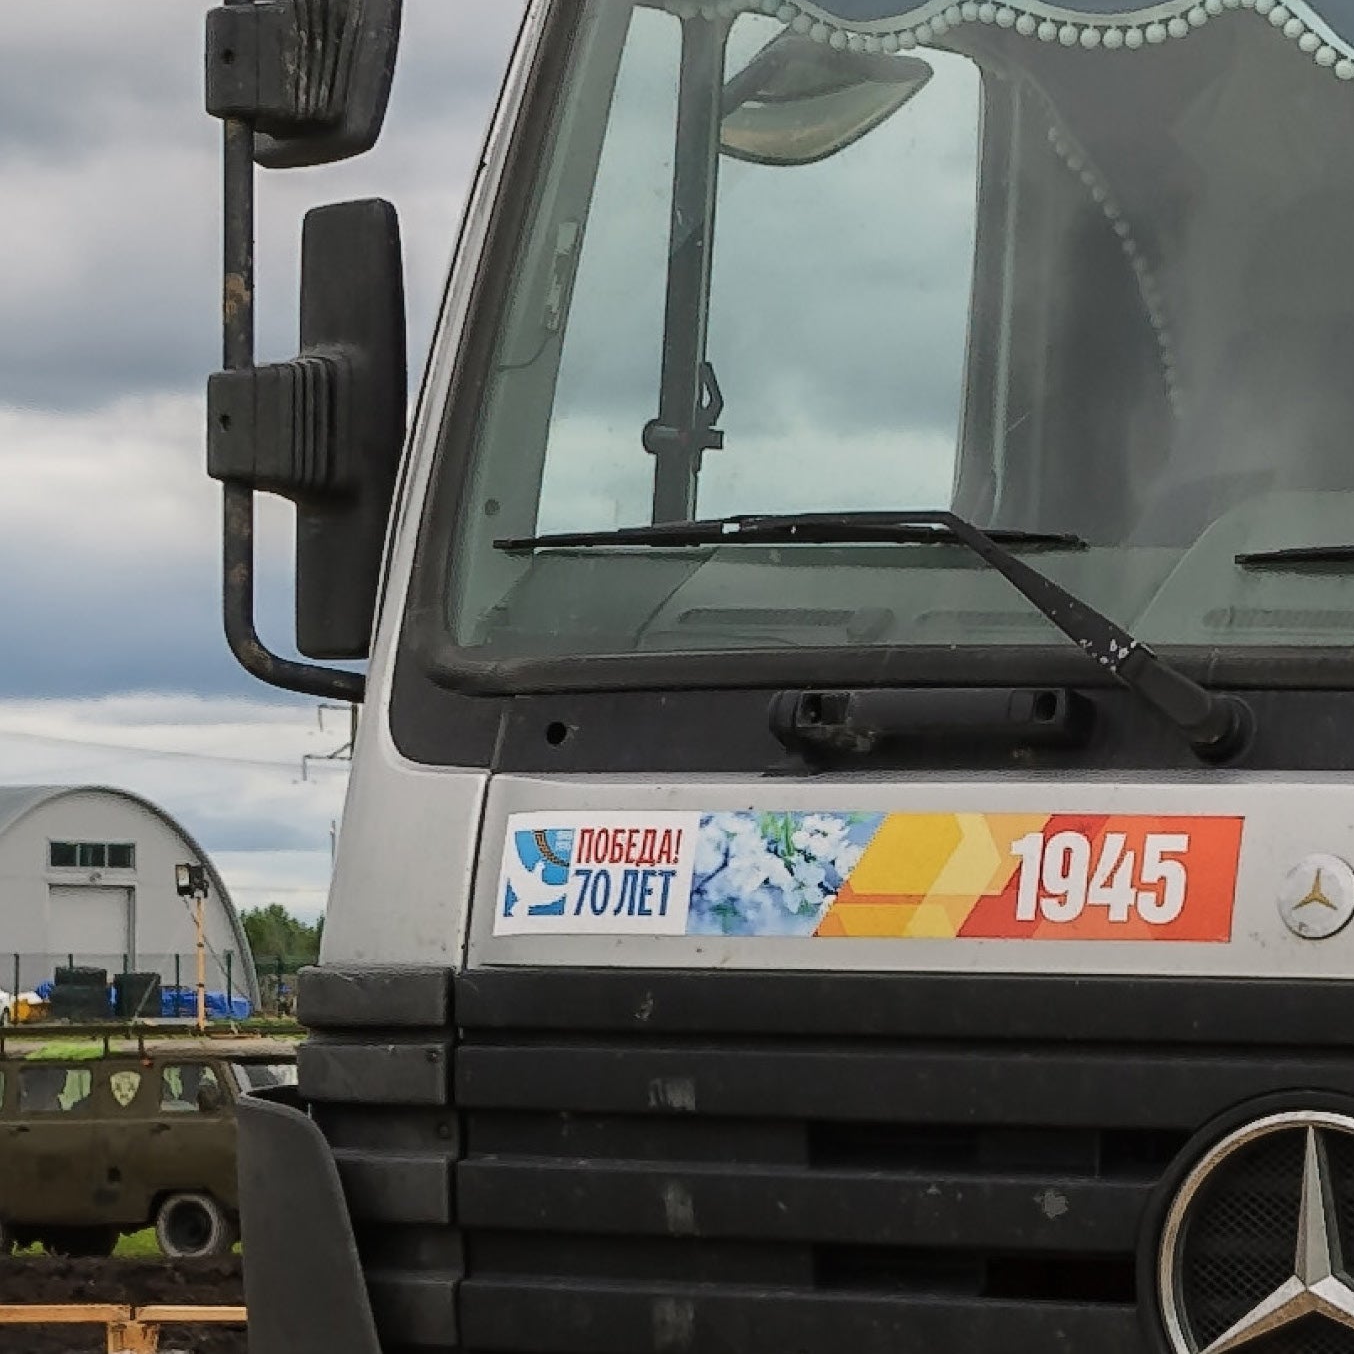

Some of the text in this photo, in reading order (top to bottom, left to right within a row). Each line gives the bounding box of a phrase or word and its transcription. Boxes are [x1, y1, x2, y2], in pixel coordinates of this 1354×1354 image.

[575, 827, 683, 867] ПОБЕДА!
[573, 869, 677, 916] 70 ЛЕТ
[1010, 830, 1190, 924] 1945
